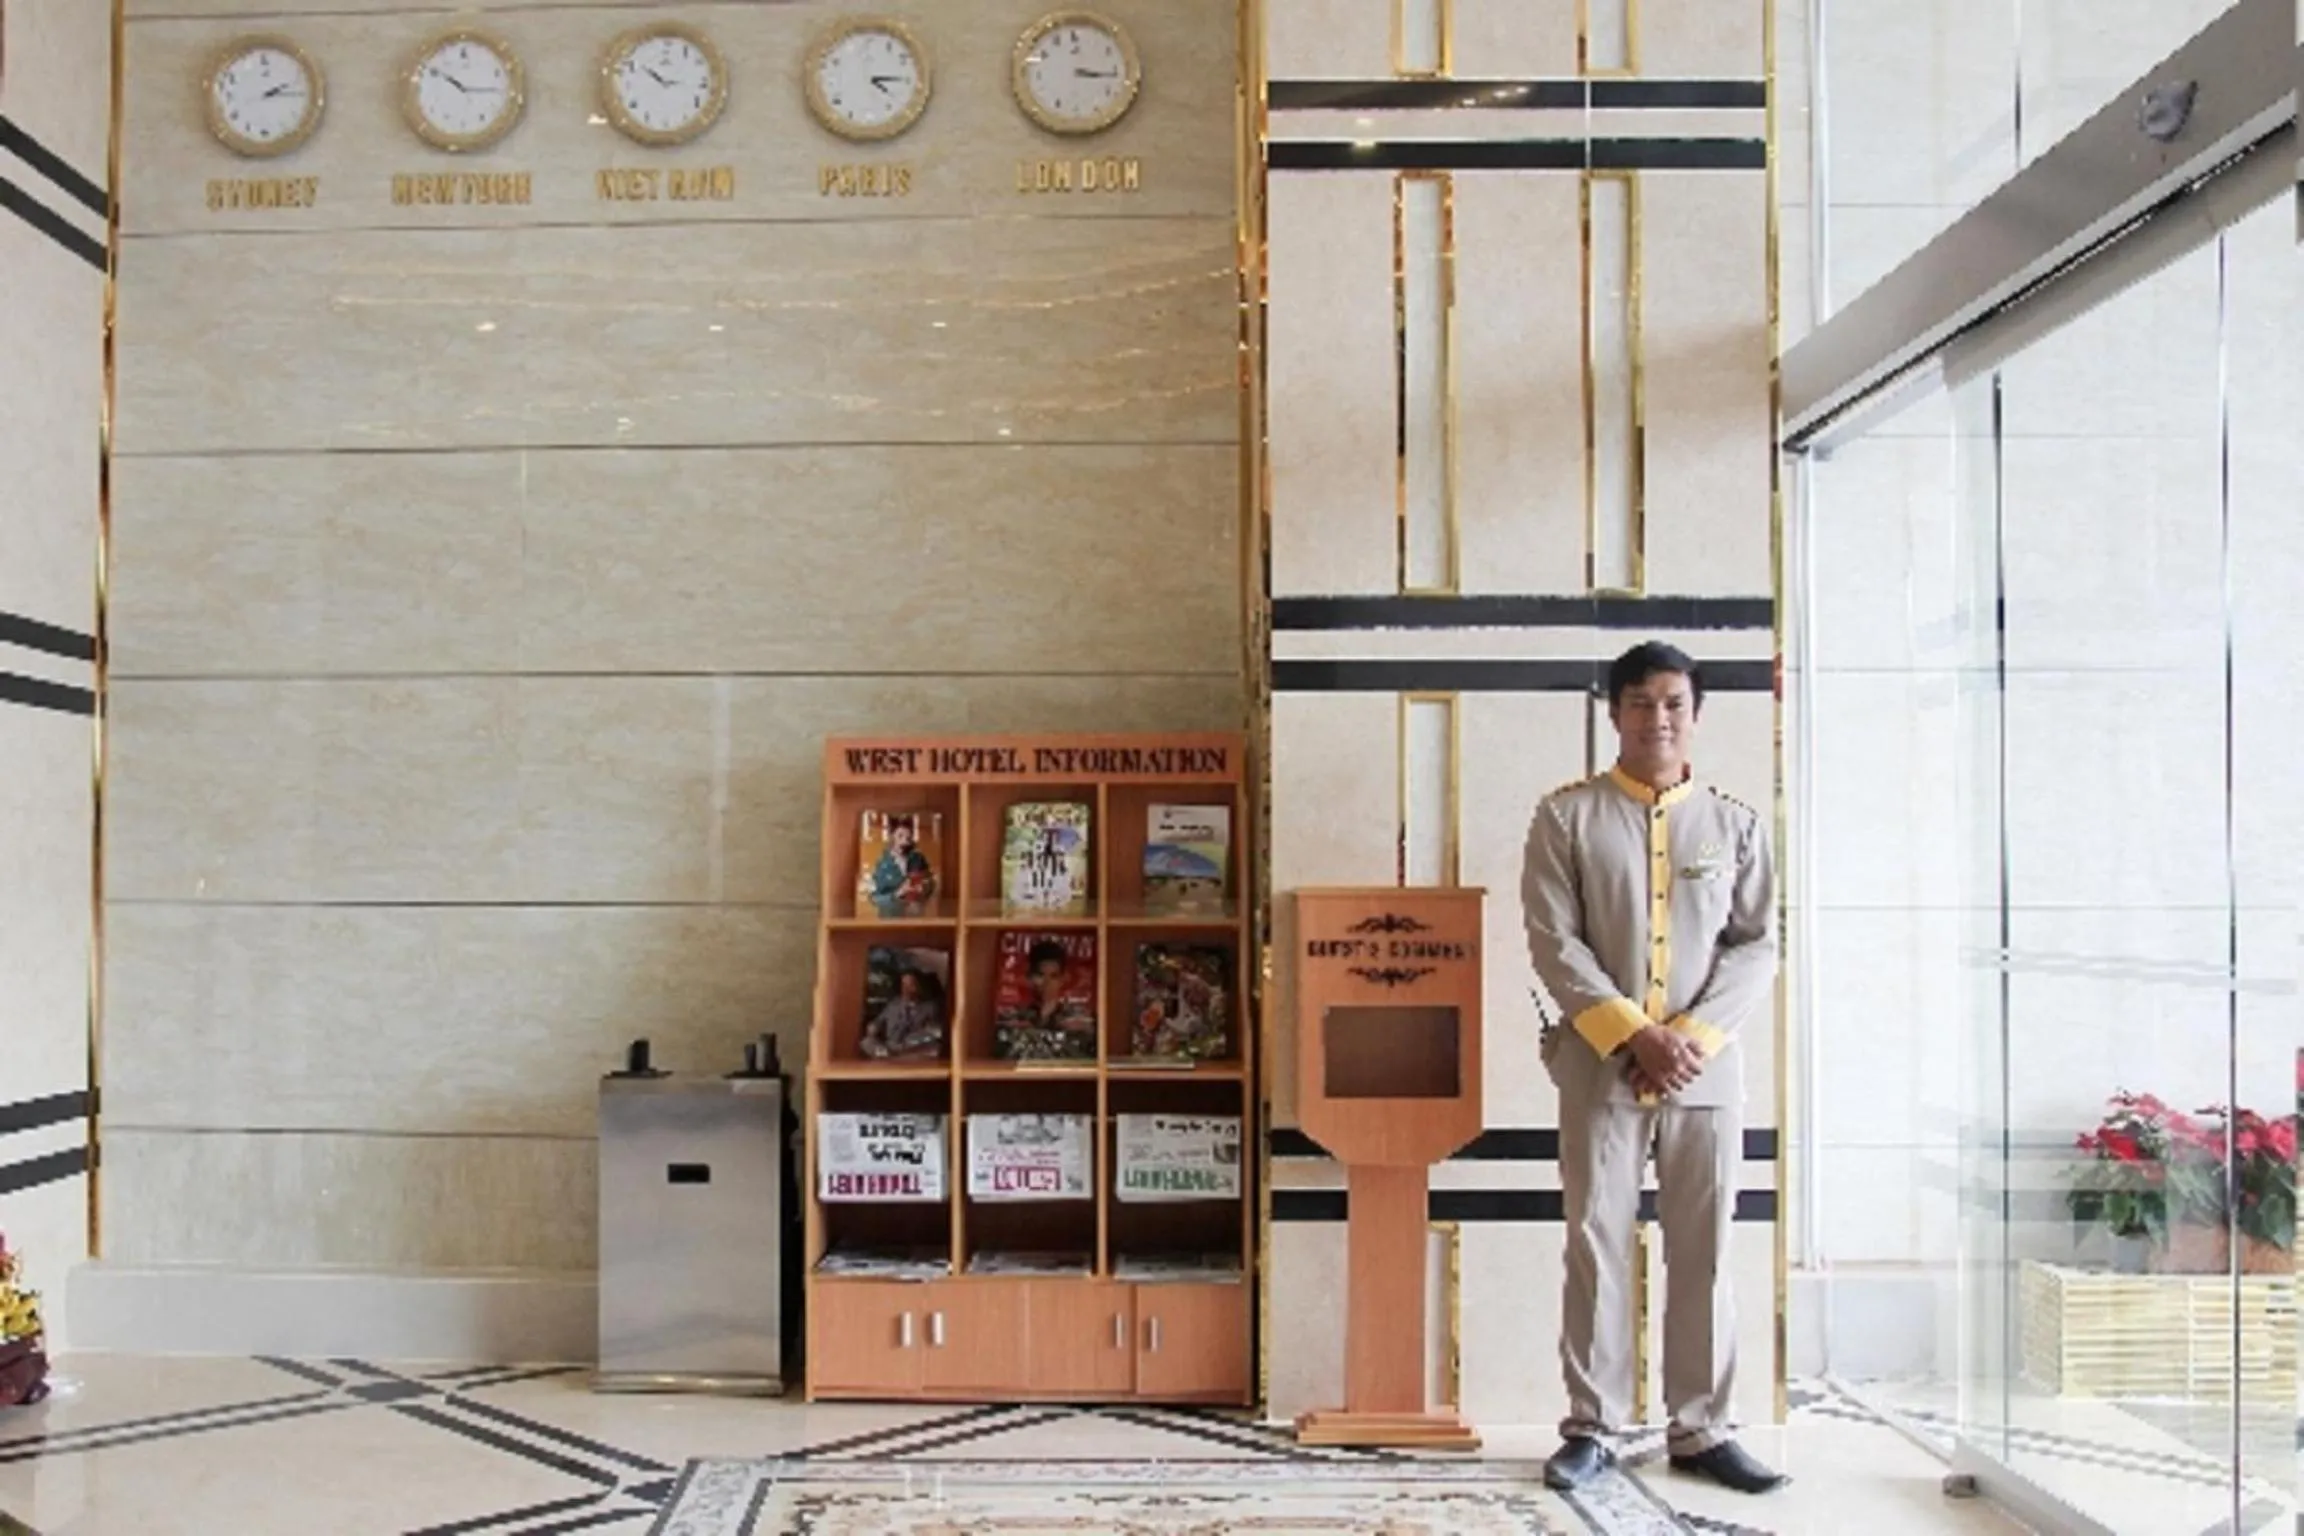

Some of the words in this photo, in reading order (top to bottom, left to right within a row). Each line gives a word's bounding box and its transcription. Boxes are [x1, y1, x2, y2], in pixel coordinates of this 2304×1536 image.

[205, 176, 319, 212] SYDNEY
[597, 167, 659, 200] VIET
[819, 163, 911, 198] PARIS
[845, 748, 922, 774] WEST
[928, 748, 1026, 774] HOTEL
[1035, 748, 1227, 774] INFORMATION
